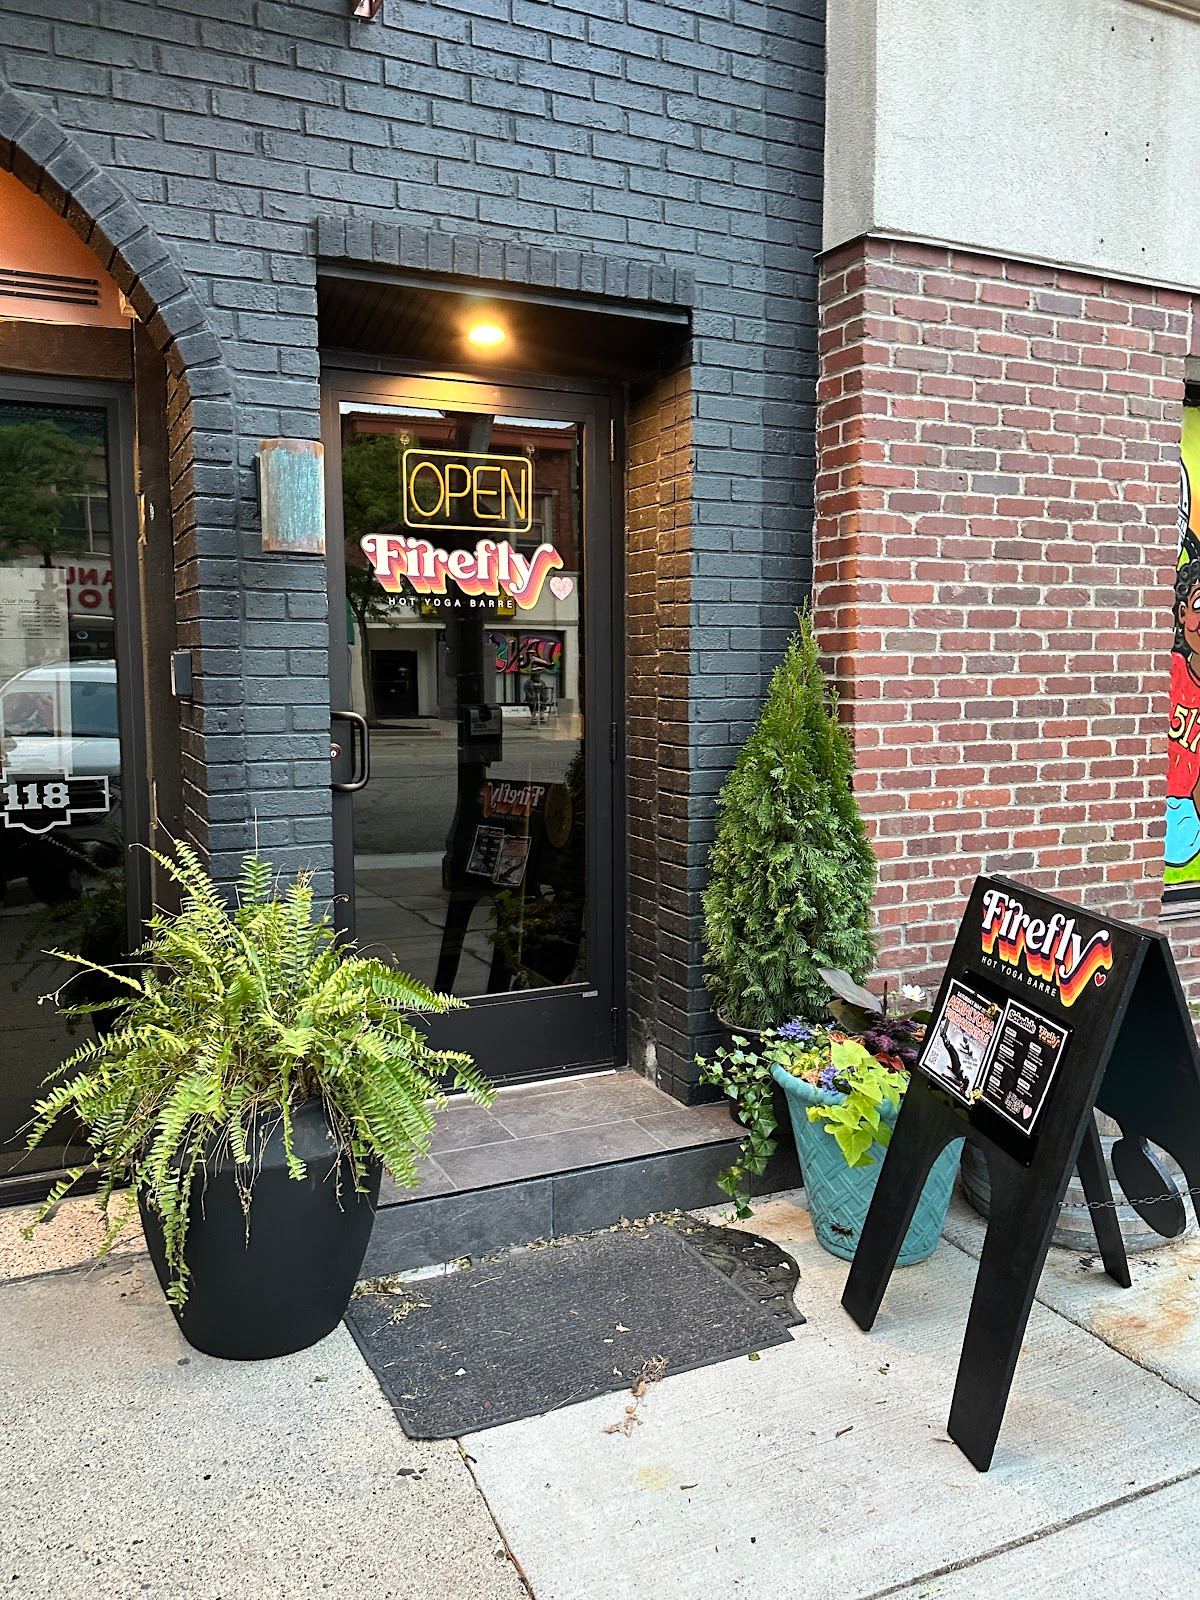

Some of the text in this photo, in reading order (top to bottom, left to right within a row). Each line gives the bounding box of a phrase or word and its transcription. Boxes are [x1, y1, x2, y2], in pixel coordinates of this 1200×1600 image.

[409, 461, 527, 520] OPEN
[360, 533, 564, 609] Firefly
[388, 597, 514, 609] HOT YOGA BARRE
[3, 782, 70, 811] 118
[981, 889, 1112, 1007] Firefly
[981, 955, 1058, 997] HOT YOGA BARRE
[943, 1006, 990, 1046] FUNDAMENTALS
[946, 993, 976, 1022] AERIAL
[971, 1009, 996, 1036] YOGA
